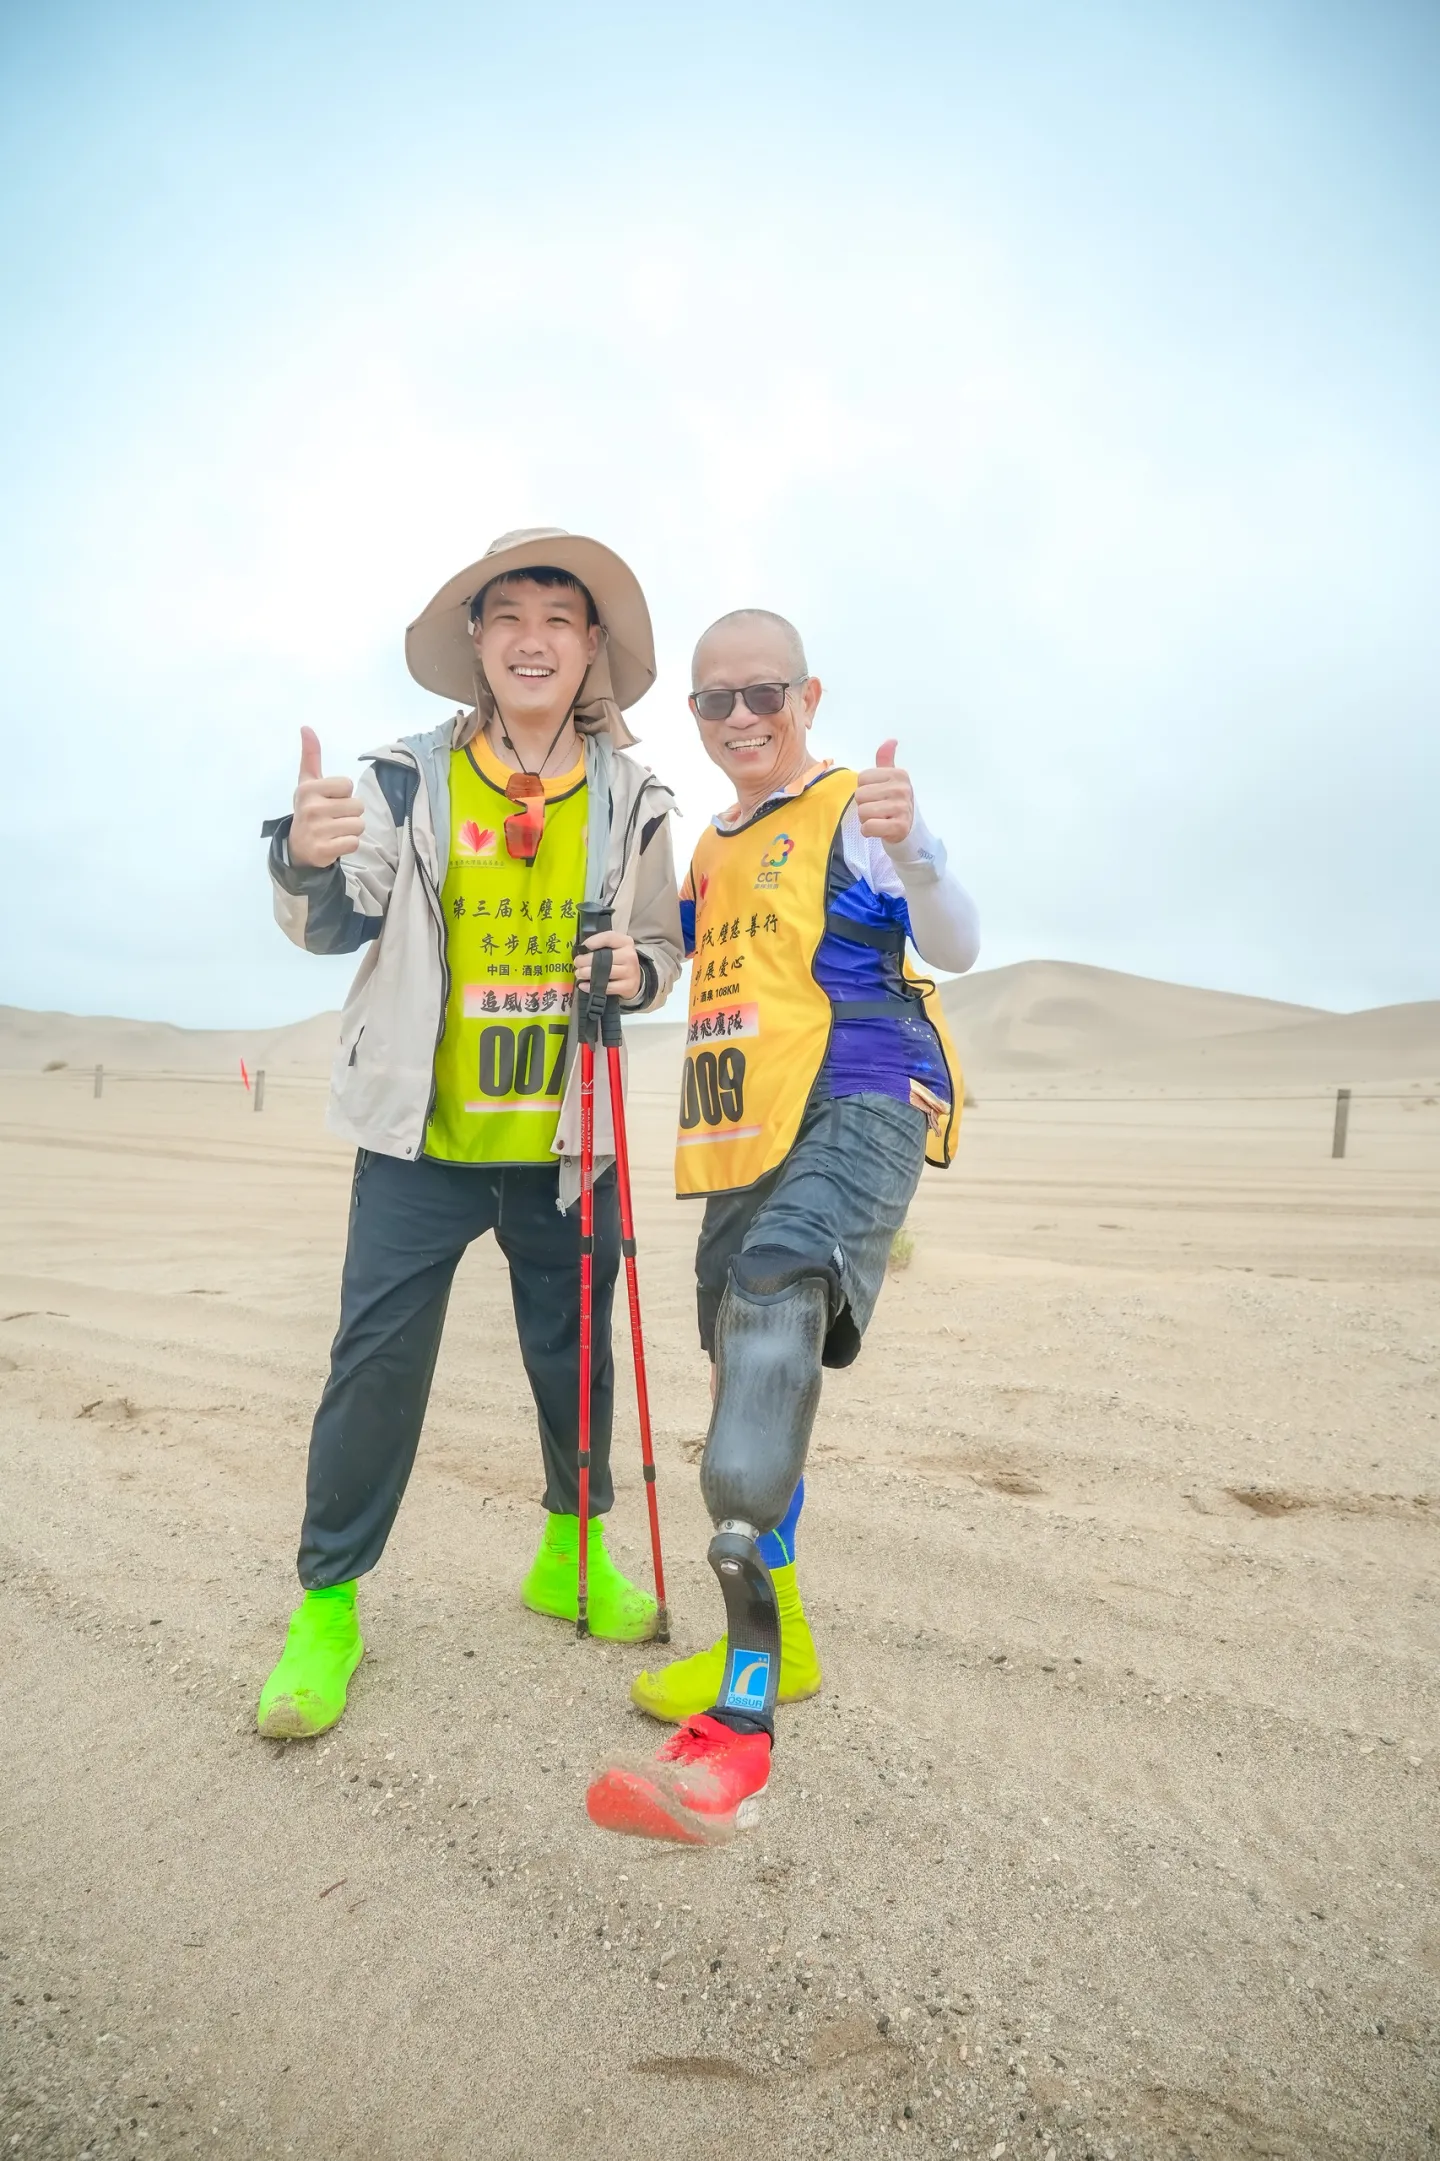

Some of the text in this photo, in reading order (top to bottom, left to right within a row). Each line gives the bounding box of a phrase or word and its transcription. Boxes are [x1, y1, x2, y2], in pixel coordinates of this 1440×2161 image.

[757, 871, 782, 883] CCT
[453, 896, 577, 921] 第三届戈壁慈
[715, 983, 740, 998] 108KM
[479, 1024, 569, 1097] 007
[679, 1047, 746, 1130] 009
[727, 1693, 763, 1708] ÖSSUR
